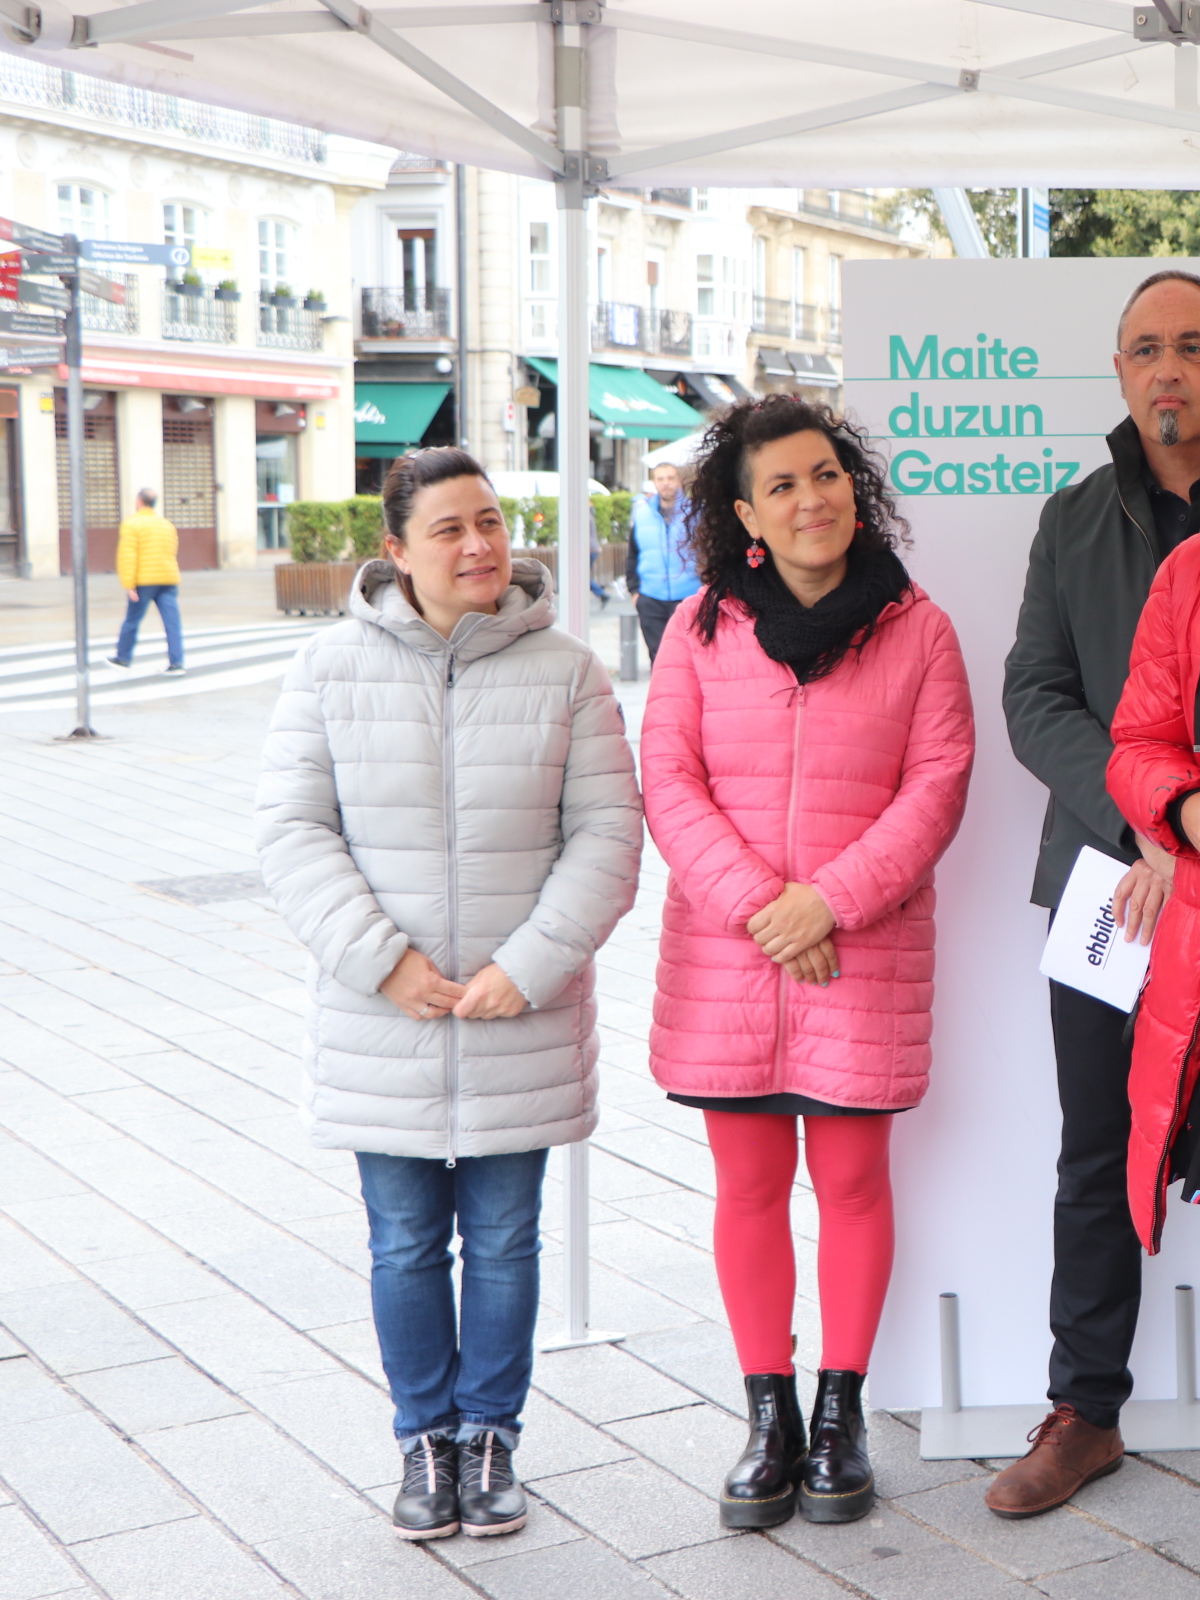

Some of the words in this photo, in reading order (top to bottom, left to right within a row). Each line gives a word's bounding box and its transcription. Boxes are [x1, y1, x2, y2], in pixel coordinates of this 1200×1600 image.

[889, 332, 1039, 379] Maite
[888, 391, 1043, 437] duzun
[889, 447, 1081, 495] Gasteiz
